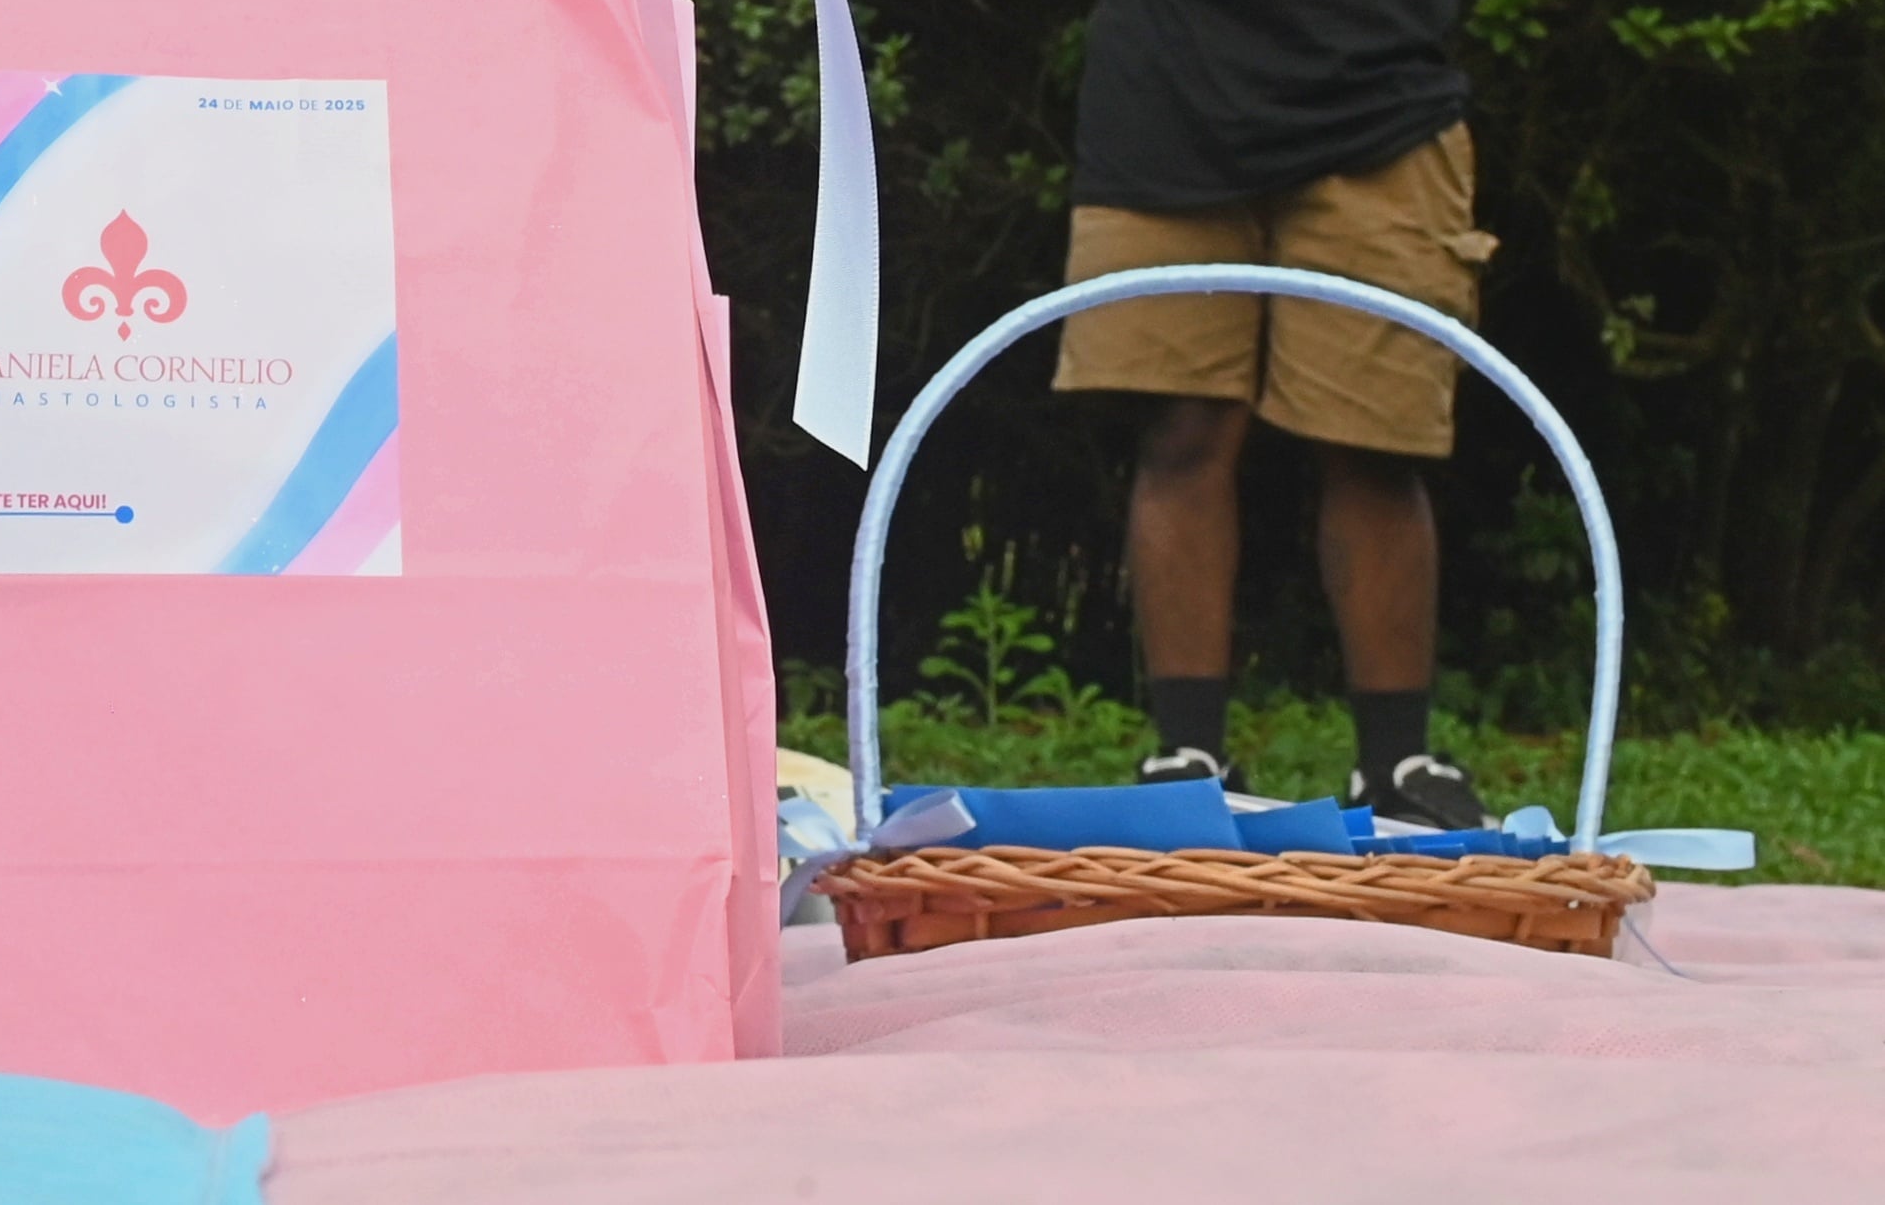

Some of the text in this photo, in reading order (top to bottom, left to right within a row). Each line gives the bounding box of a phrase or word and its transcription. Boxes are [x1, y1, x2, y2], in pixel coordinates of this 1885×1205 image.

[198, 98, 365, 111] 24 DE MAIO DE 2025
[113, 355, 293, 386] CORNELIO
[17, 494, 49, 509] TER
[53, 494, 107, 510] AQUI!
